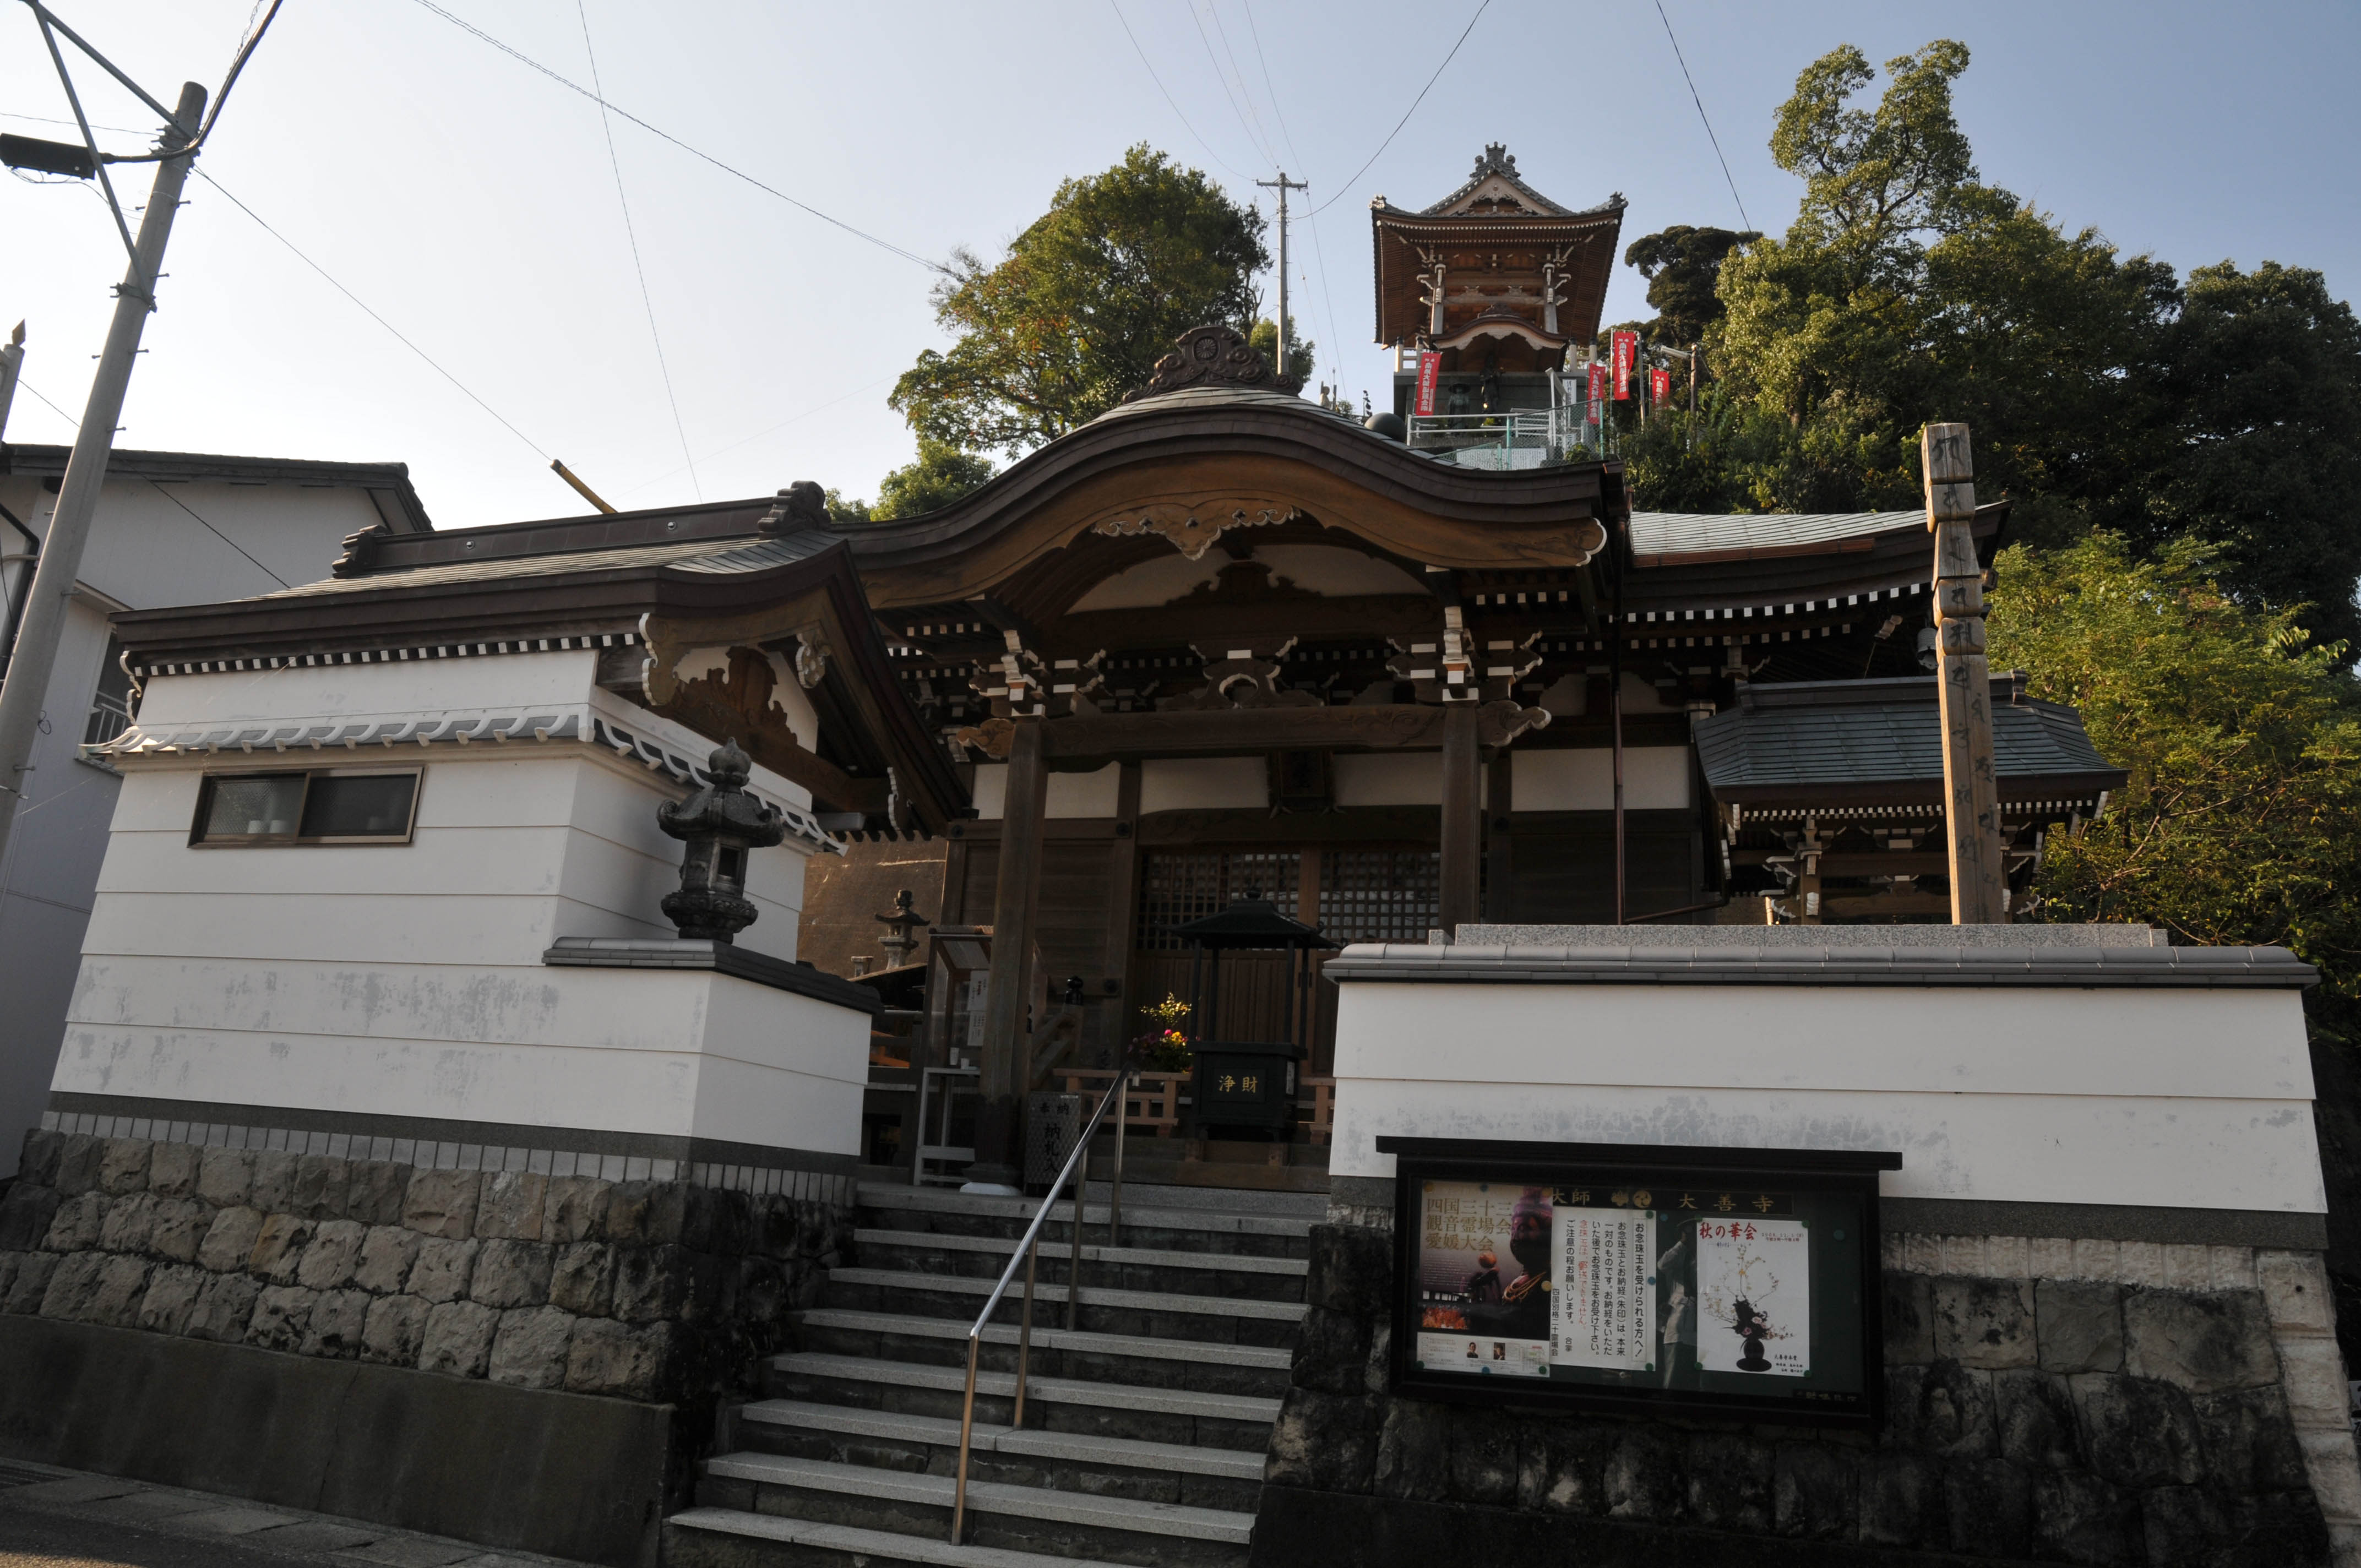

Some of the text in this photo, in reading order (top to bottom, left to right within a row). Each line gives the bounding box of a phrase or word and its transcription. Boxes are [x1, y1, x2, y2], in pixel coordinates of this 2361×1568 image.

[1218, 1075, 1258, 1093] 浄財
[1040, 1102, 1069, 1115] 奉納
[1045, 1123, 1060, 1173] 納札入
[1427, 1198, 1512, 1217] 四国三十三
[1678, 1193, 1775, 1213] 大善寺
[1427, 1215, 1511, 1235] 観音霊場会
[1700, 1222, 1757, 1242] 秋の華会
[1426, 1233, 1494, 1252] 愛媛大会
[1551, 1288, 1559, 1356] 四国別格二十霊場会
